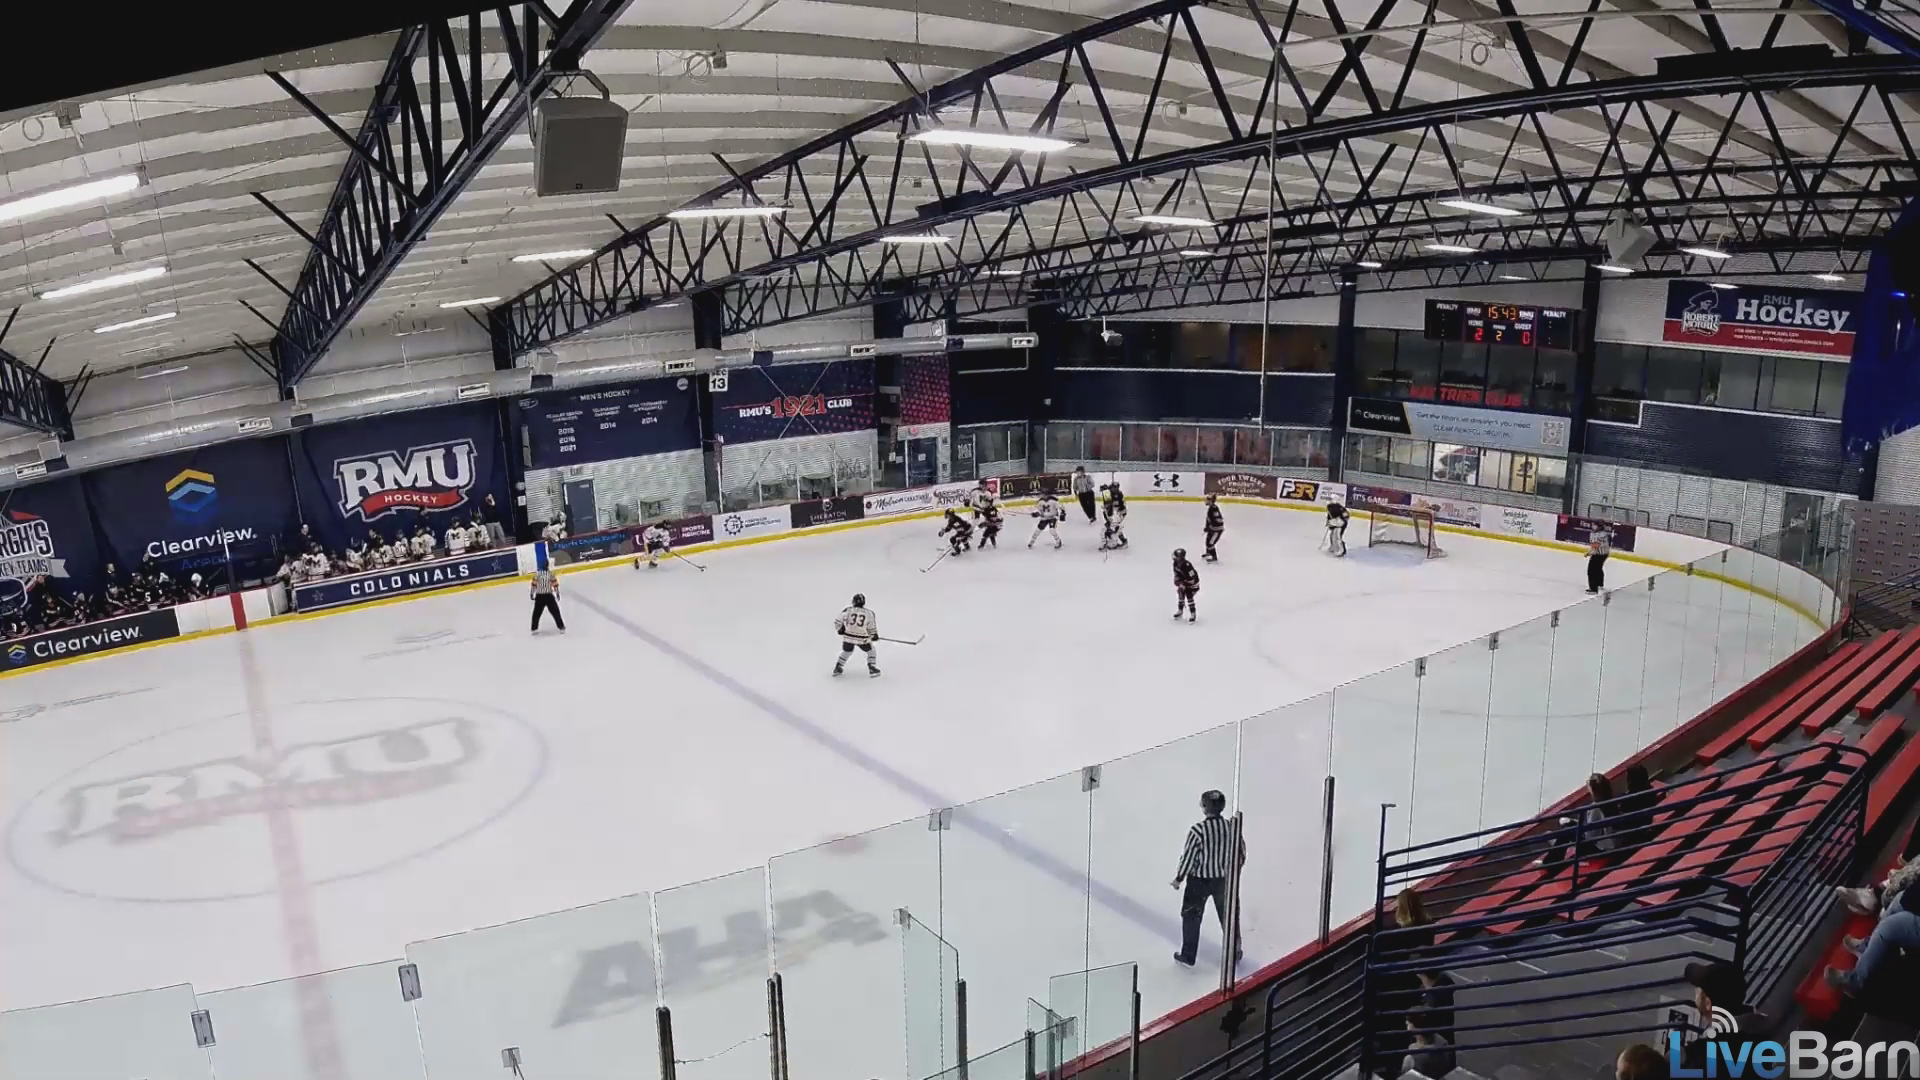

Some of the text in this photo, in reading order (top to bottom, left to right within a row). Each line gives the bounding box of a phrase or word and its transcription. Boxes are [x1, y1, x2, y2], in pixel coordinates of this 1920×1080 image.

[1763, 294, 1792, 306] RMU
[1542, 310, 1567, 319] PENALTY
[1683, 311, 1720, 322] ROBERT
[1735, 298, 1850, 334] Hockey
[1682, 319, 1720, 333] MORRIS
[1474, 327, 1531, 345] 2 2 0
[711, 377, 726, 389] 13
[603, 389, 631, 399] HOCKEY
[739, 393, 853, 419] RMU'S 1921 CLUB
[1363, 410, 1401, 423] Clearview
[339, 444, 470, 510] RMU
[384, 494, 437, 504] HOCKEY
[681, 524, 705, 533] SPORTS
[681, 529, 711, 538] MEDICINE
[16, 558, 49, 574] TEAMS
[350, 564, 470, 596] COLONIALS
[849, 613, 866, 627] 33
